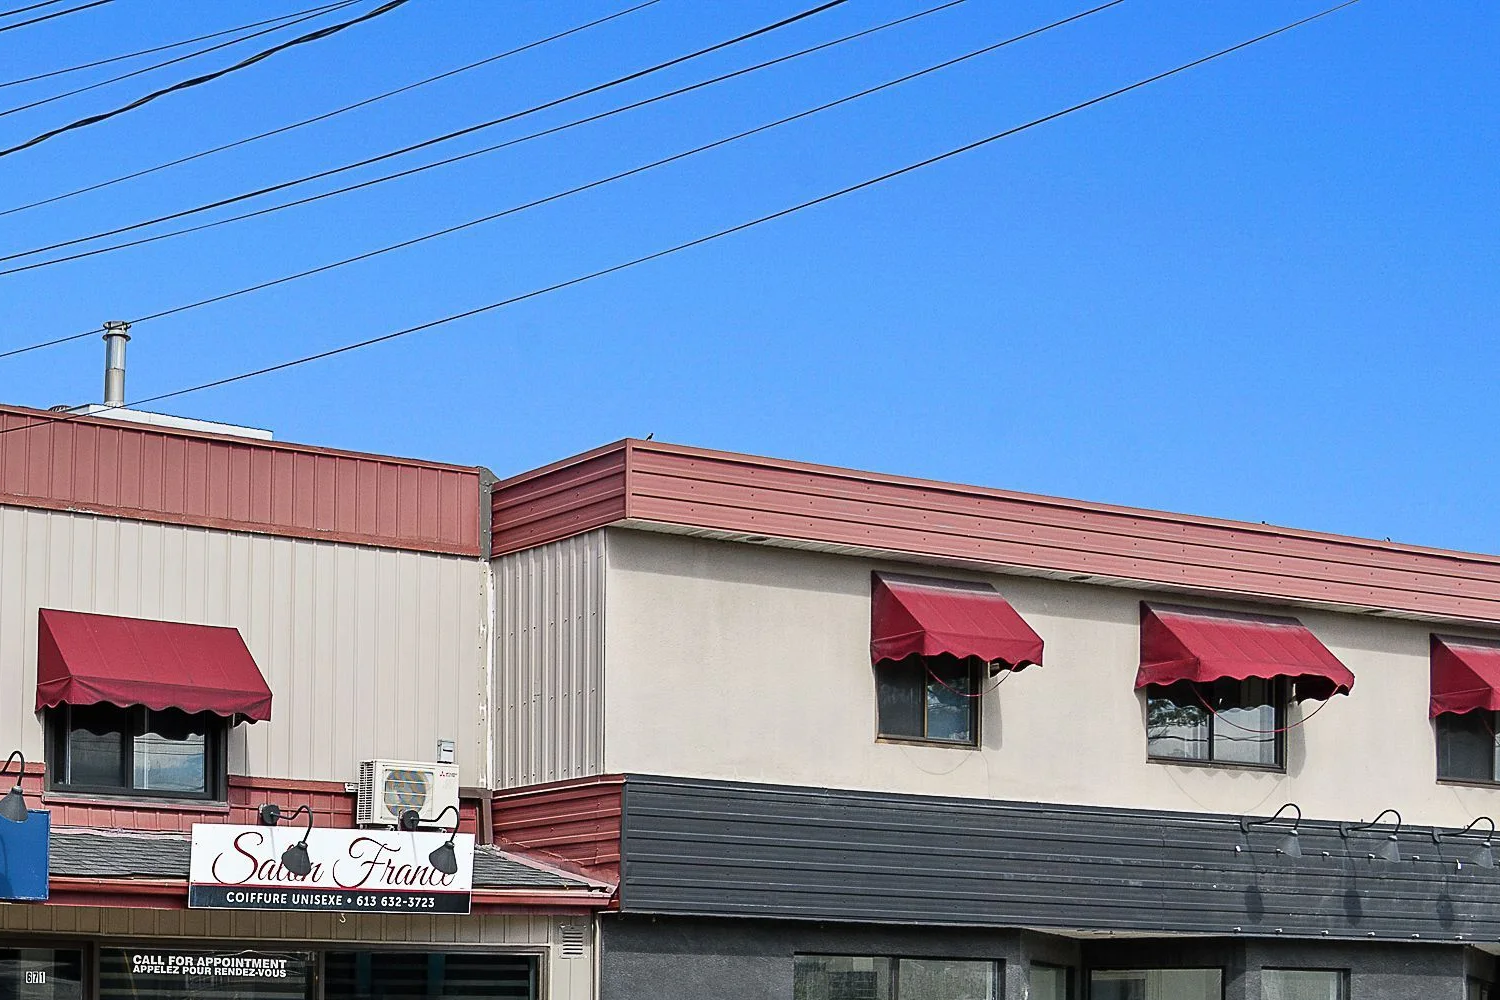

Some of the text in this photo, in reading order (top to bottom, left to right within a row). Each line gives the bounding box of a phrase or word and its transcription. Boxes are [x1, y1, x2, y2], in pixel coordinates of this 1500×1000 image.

[226, 891, 435, 908] COIFFURE UNISEXE 613 632-3723
[132, 954, 287, 969] CALL FOR APPOINTMENT
[26, 972, 45, 983] 671
[132, 965, 287, 978] APPELEZ POUR RENDEZ-VOUS
